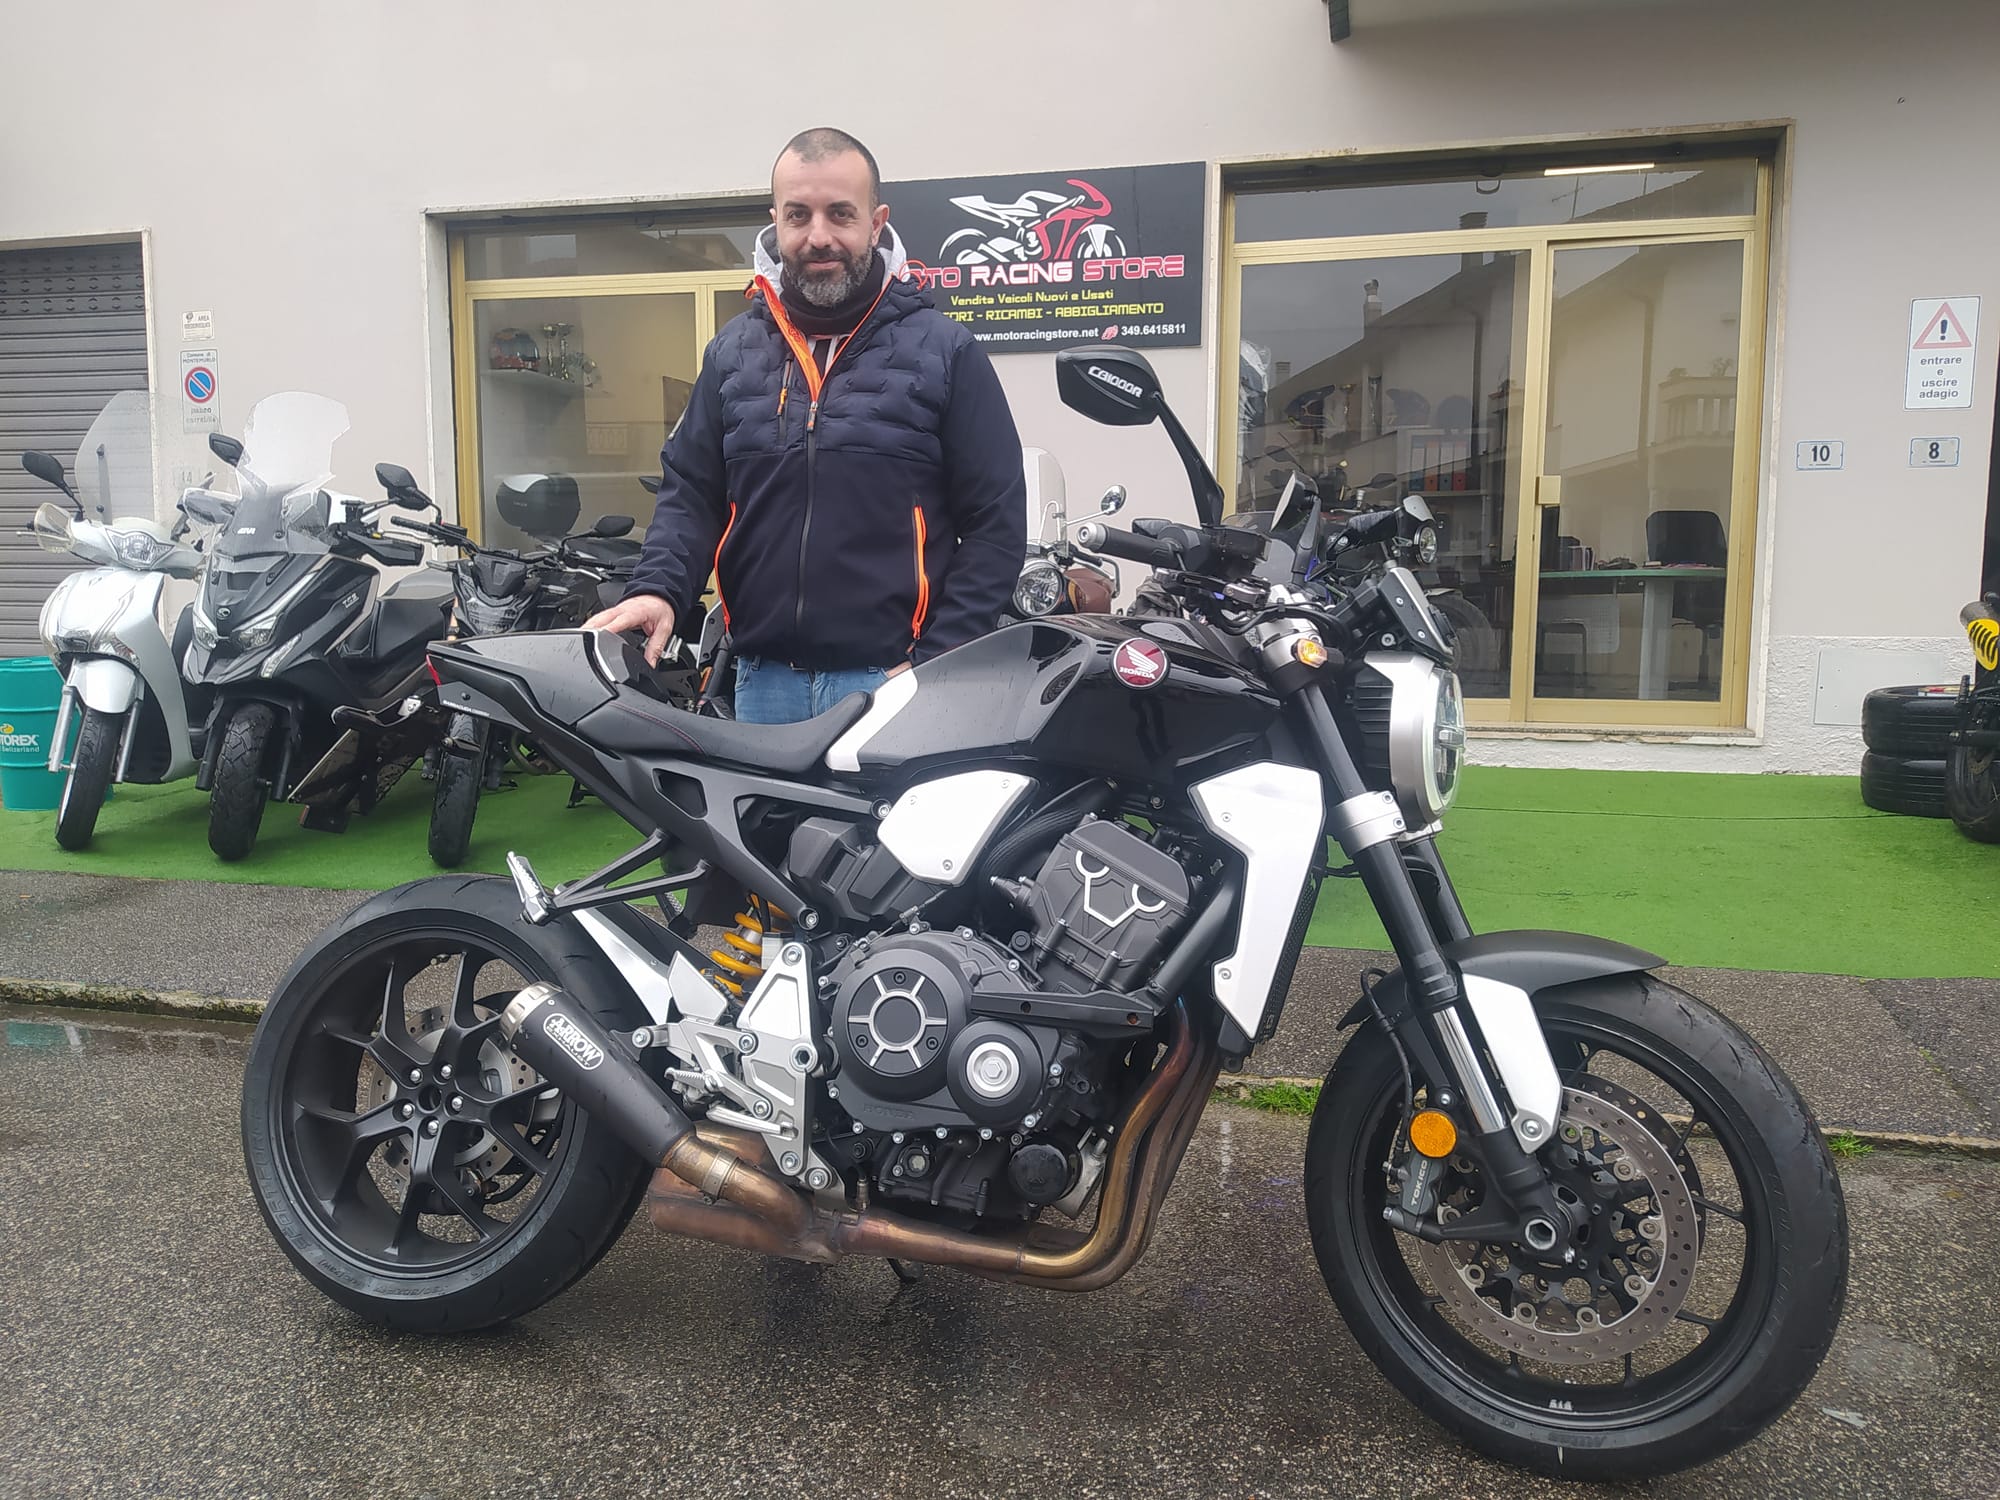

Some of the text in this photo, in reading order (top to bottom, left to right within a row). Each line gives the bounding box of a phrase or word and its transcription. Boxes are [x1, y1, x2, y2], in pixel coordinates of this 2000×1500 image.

[970, 261, 1073, 287] RACING
[1083, 255, 1185, 281] STORE
[951, 289, 1114, 306] Vendita Veicoli Nuovi e Usati
[986, 308, 1043, 320] RICAMBI
[1055, 303, 1164, 318] ABBIGLIAMENTO
[1121, 324, 1186, 336] 349.6415811
[1920, 356, 1962, 366] entrare
[1937, 368, 1944, 376] e
[1088, 365, 1144, 398] CB1000R
[1921, 379, 1958, 388] uscire
[1919, 390, 1959, 400] adagio
[1811, 445, 1831, 462] 10
[1928, 442, 1940, 460] 8
[1119, 666, 1156, 680] HONDA
[549, 1017, 602, 1062] ARROW
[1410, 1159, 1428, 1206] TOKICO
